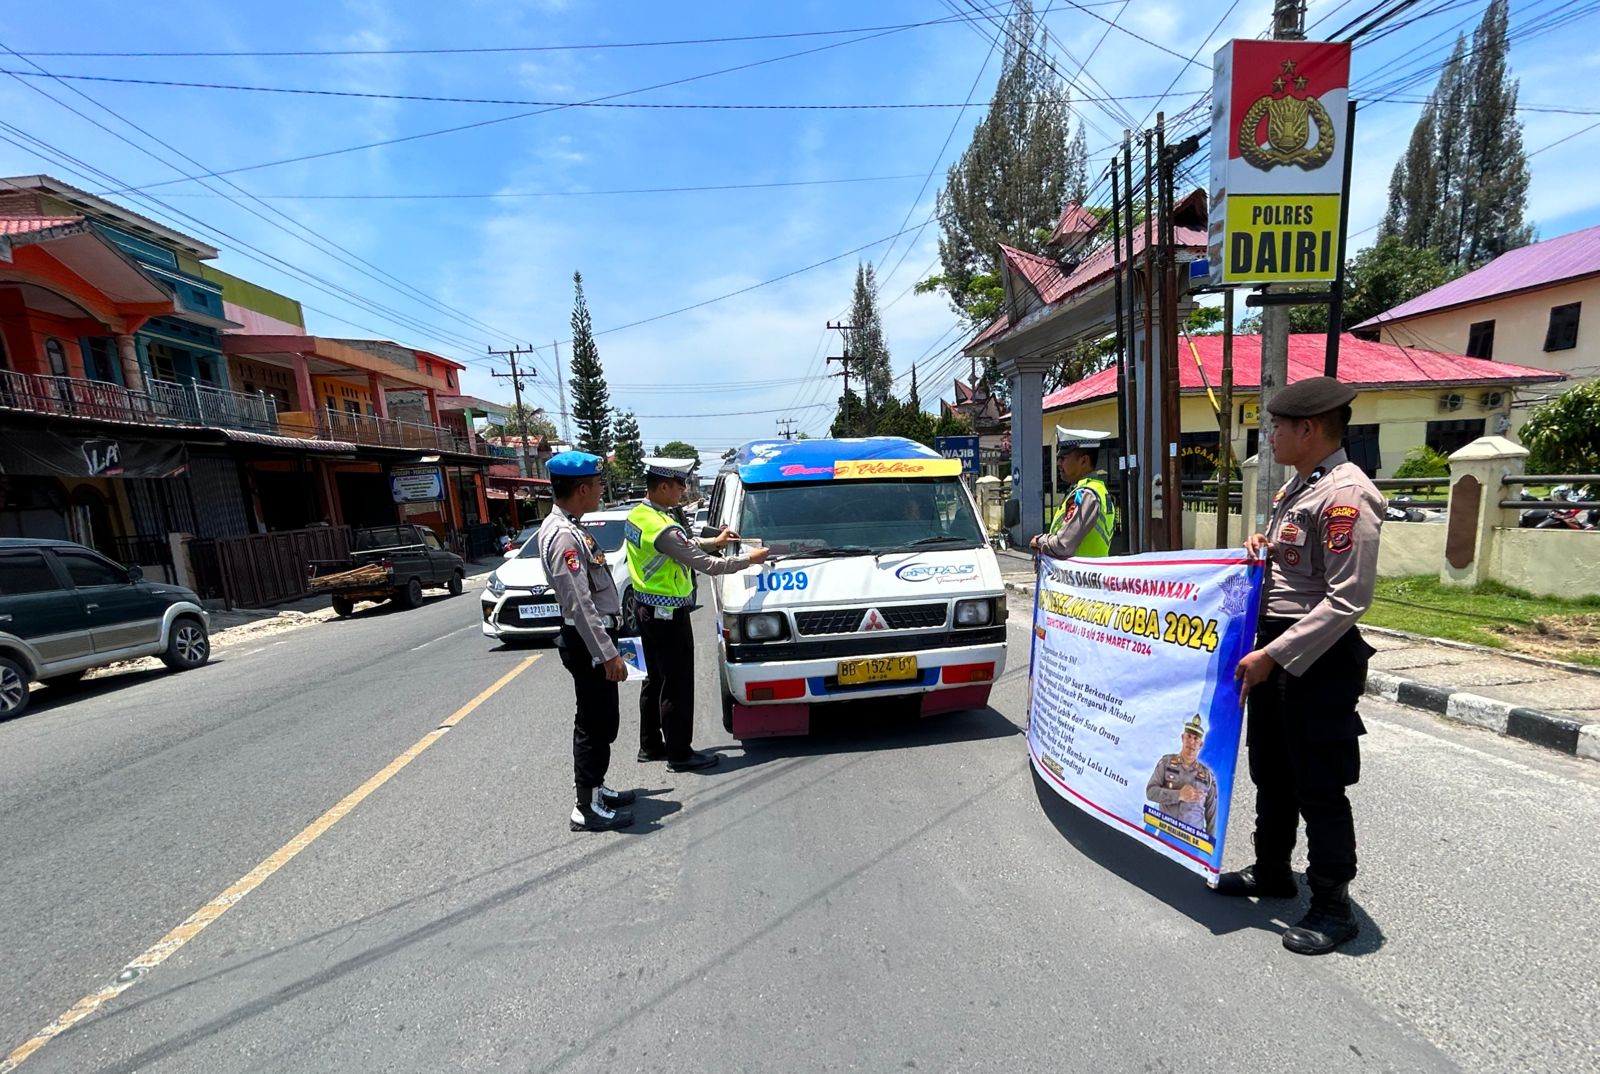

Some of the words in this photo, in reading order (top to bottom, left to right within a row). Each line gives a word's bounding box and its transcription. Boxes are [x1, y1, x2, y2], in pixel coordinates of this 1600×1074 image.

[1252, 205, 1313, 225] POLRES
[1231, 230, 1331, 274] DAIRI
[942, 449, 974, 458] WAJIB
[756, 571, 808, 592] 1029
[1103, 576, 1195, 600] MELAKSANAKAN
[1114, 605, 1160, 640] TOBA
[1164, 611, 1219, 653] 2024
[1105, 634, 1131, 650] MARET
[1131, 641, 1151, 656] 2024
[841, 662, 856, 676] BB
[1084, 684, 1123, 706] Berkendara
[1077, 693, 1107, 713] Pengaruh
[1108, 706, 1136, 724] Alkohol
[1098, 726, 1120, 745] Orang
[1087, 758, 1103, 773] Lalu
[1104, 767, 1128, 787] Lintas
